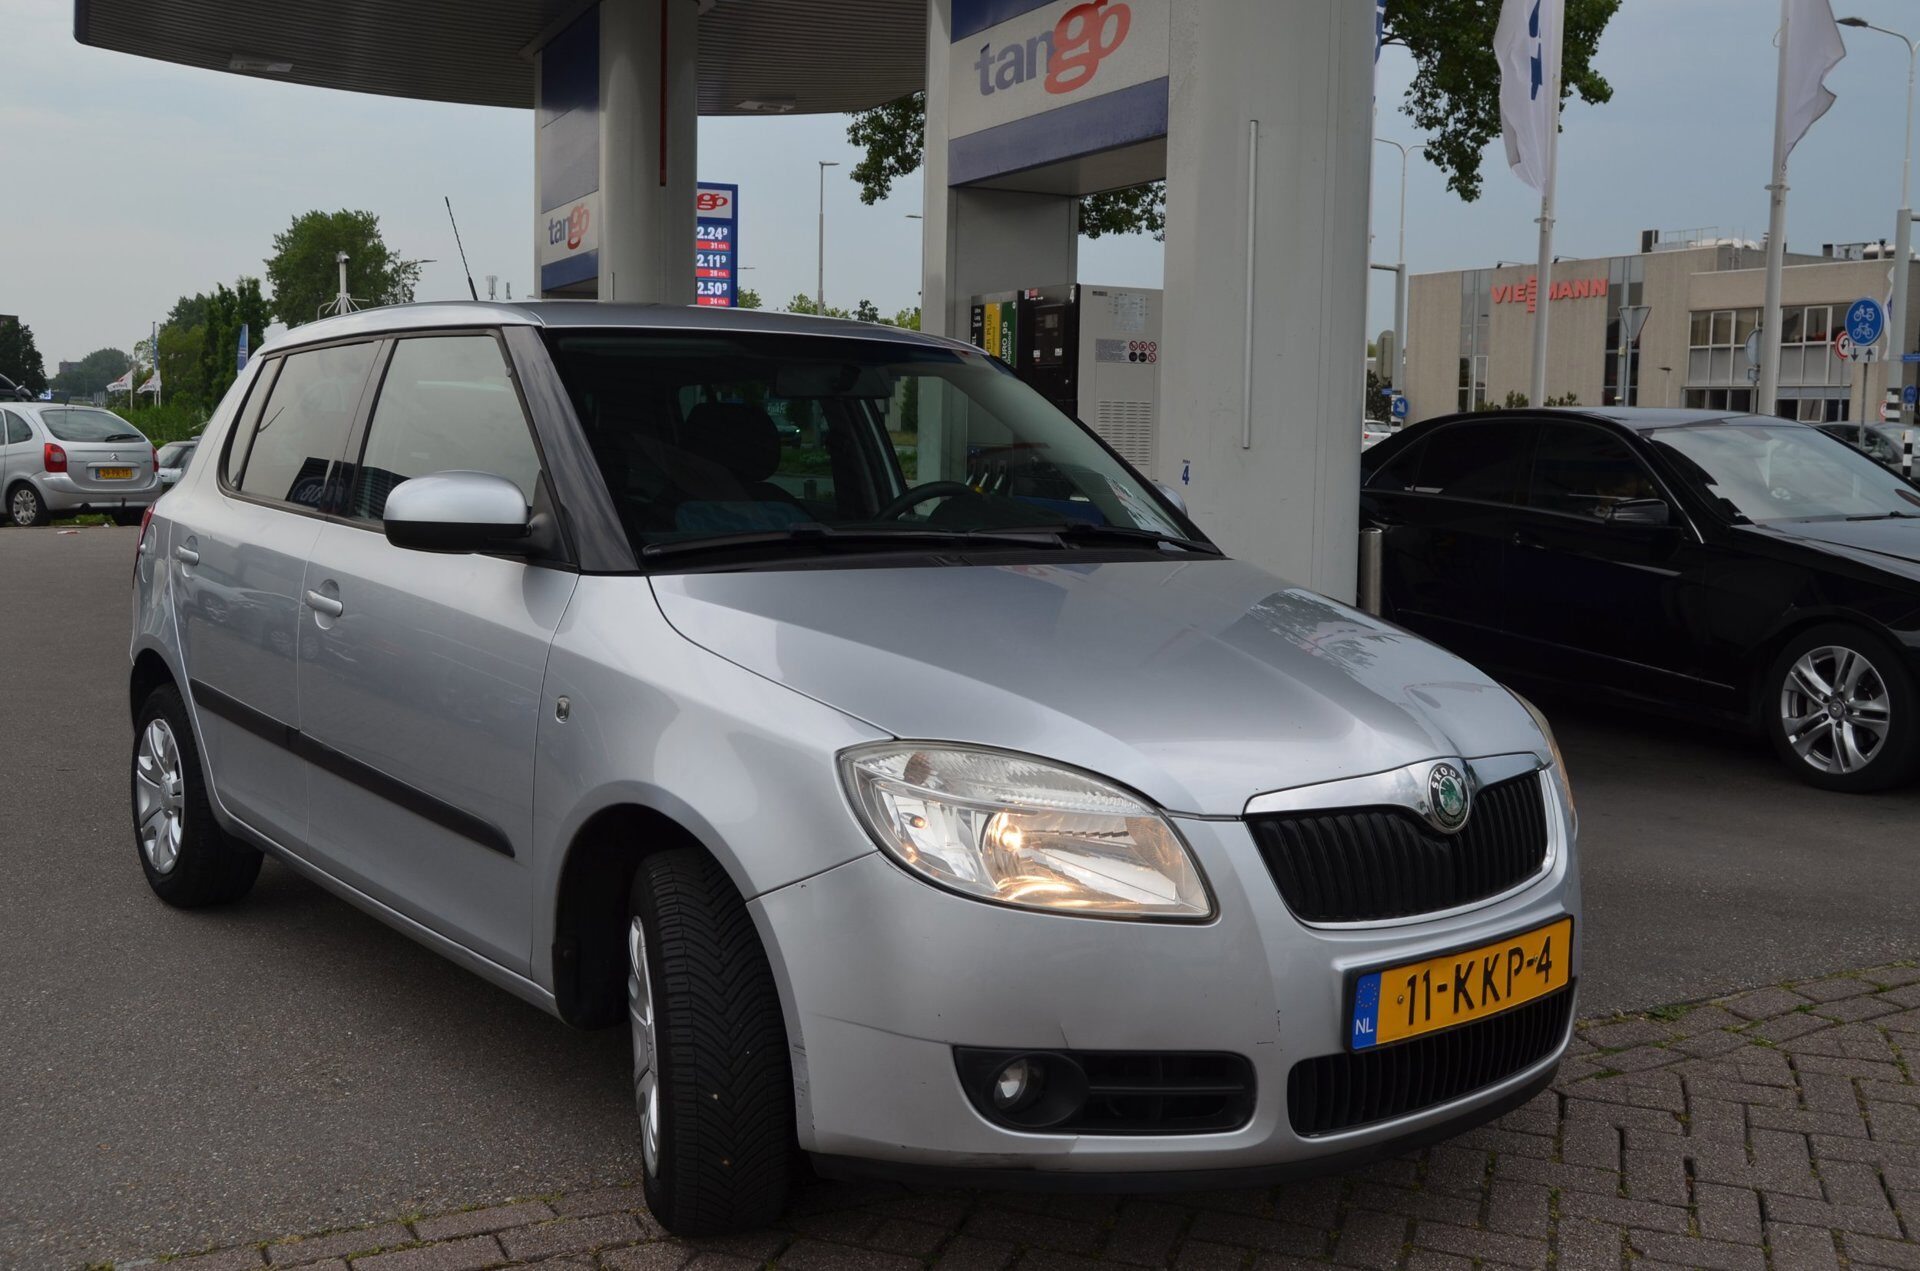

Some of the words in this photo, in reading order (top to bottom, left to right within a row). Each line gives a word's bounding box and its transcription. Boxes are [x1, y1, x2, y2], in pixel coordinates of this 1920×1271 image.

[974, 0, 1132, 95] tango
[548, 203, 590, 250] tango
[1182, 465, 1190, 485] 4
[1407, 936, 1553, 1026] 11-KKP-4
[1355, 1018, 1374, 1036] NL
